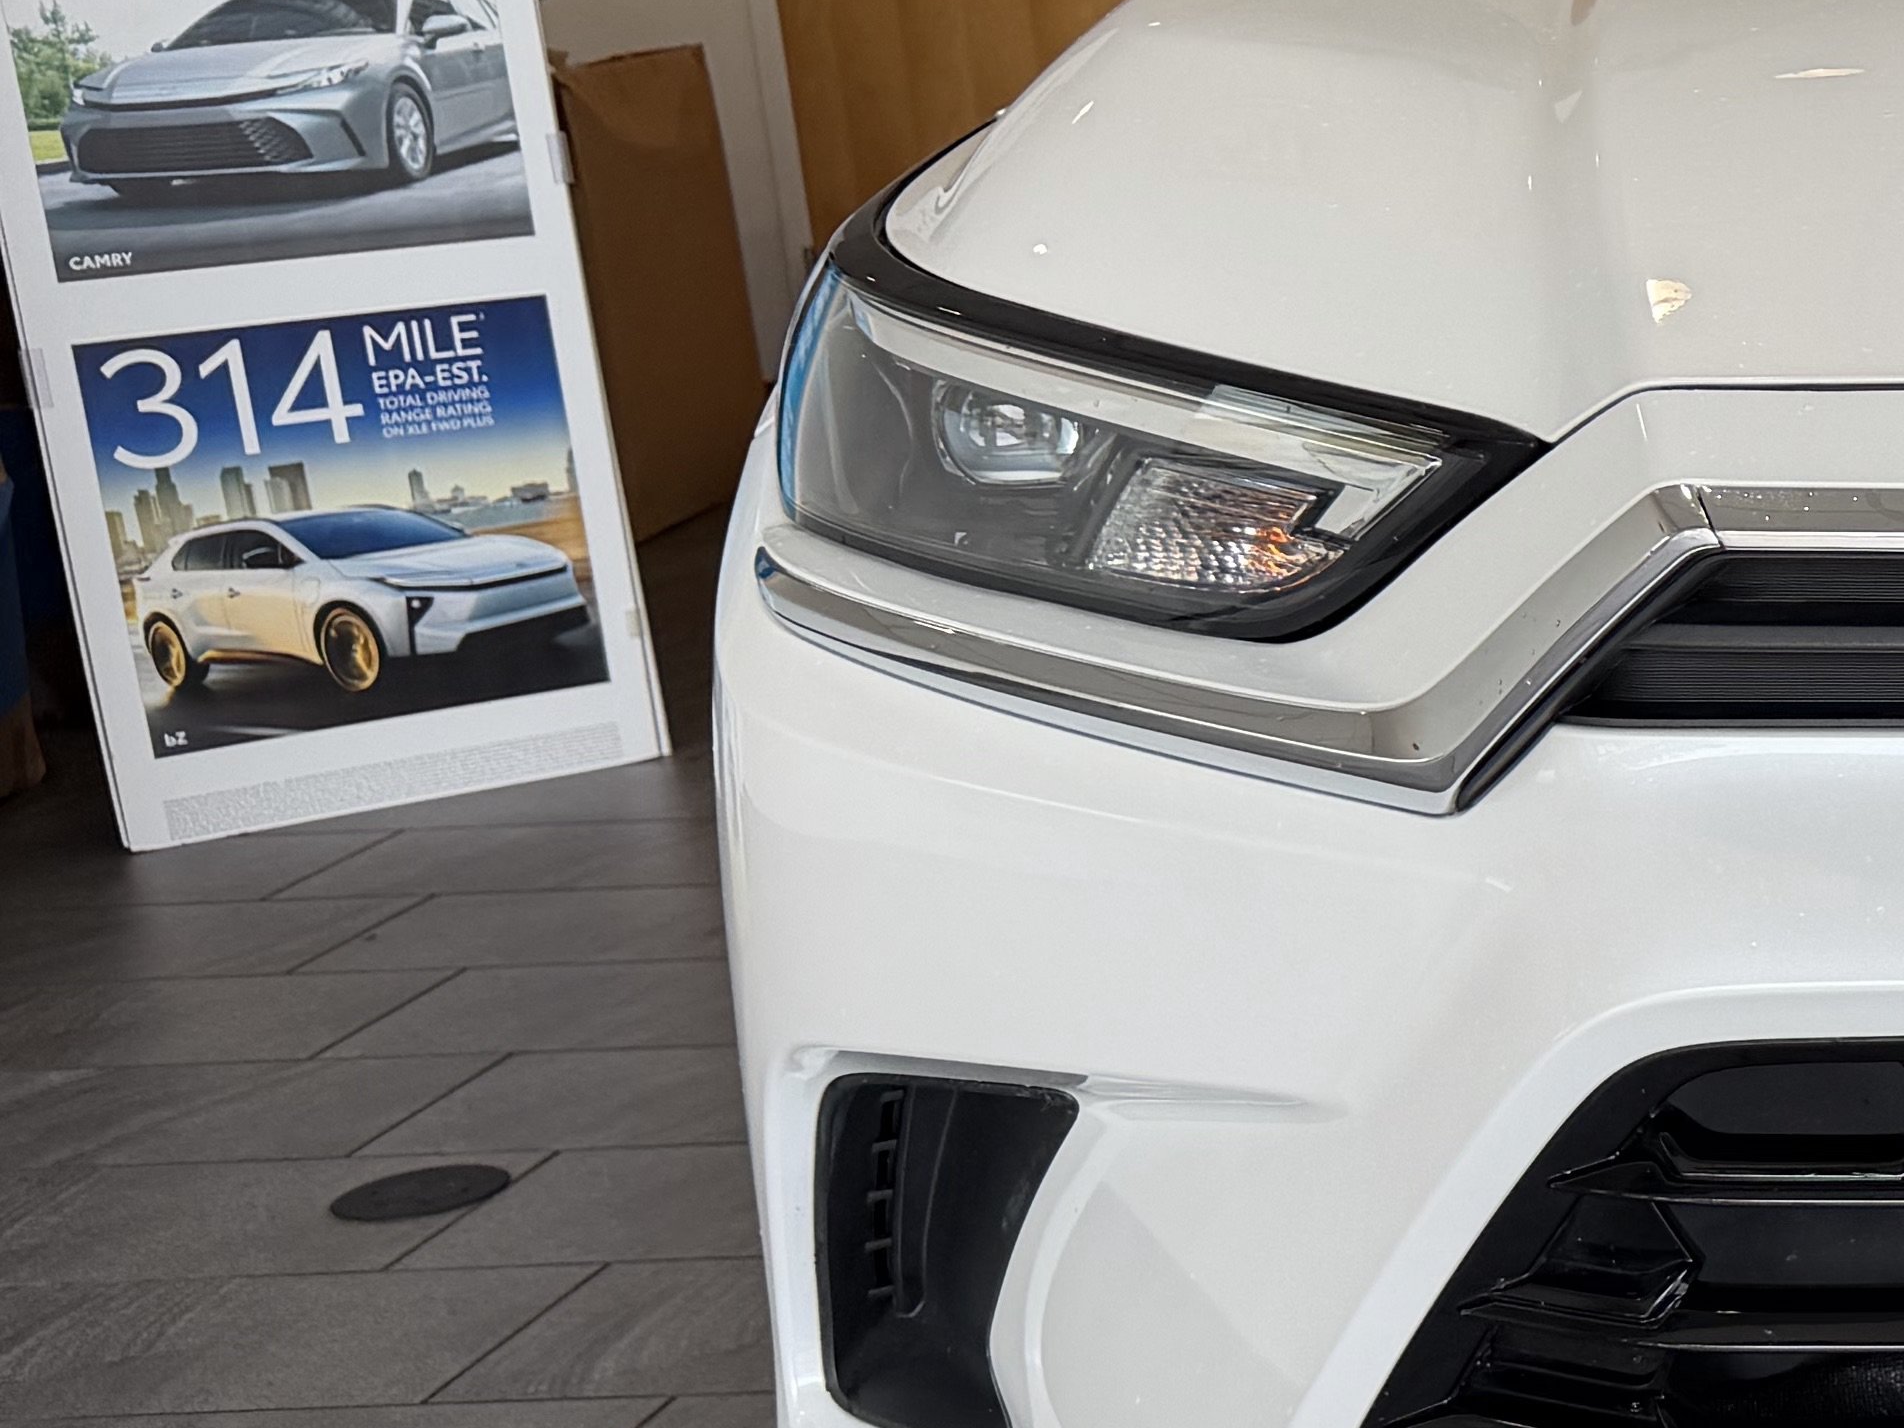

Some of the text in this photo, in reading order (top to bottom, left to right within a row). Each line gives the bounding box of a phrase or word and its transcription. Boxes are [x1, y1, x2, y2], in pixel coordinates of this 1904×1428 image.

[68, 251, 133, 271] CAMRY
[371, 360, 489, 394] EPA-EST.
[100, 313, 484, 470] 314 MILE
[377, 385, 491, 411] TOTAL DRIVING
[380, 400, 493, 426] RANGE RATING
[382, 426, 405, 439] ON
